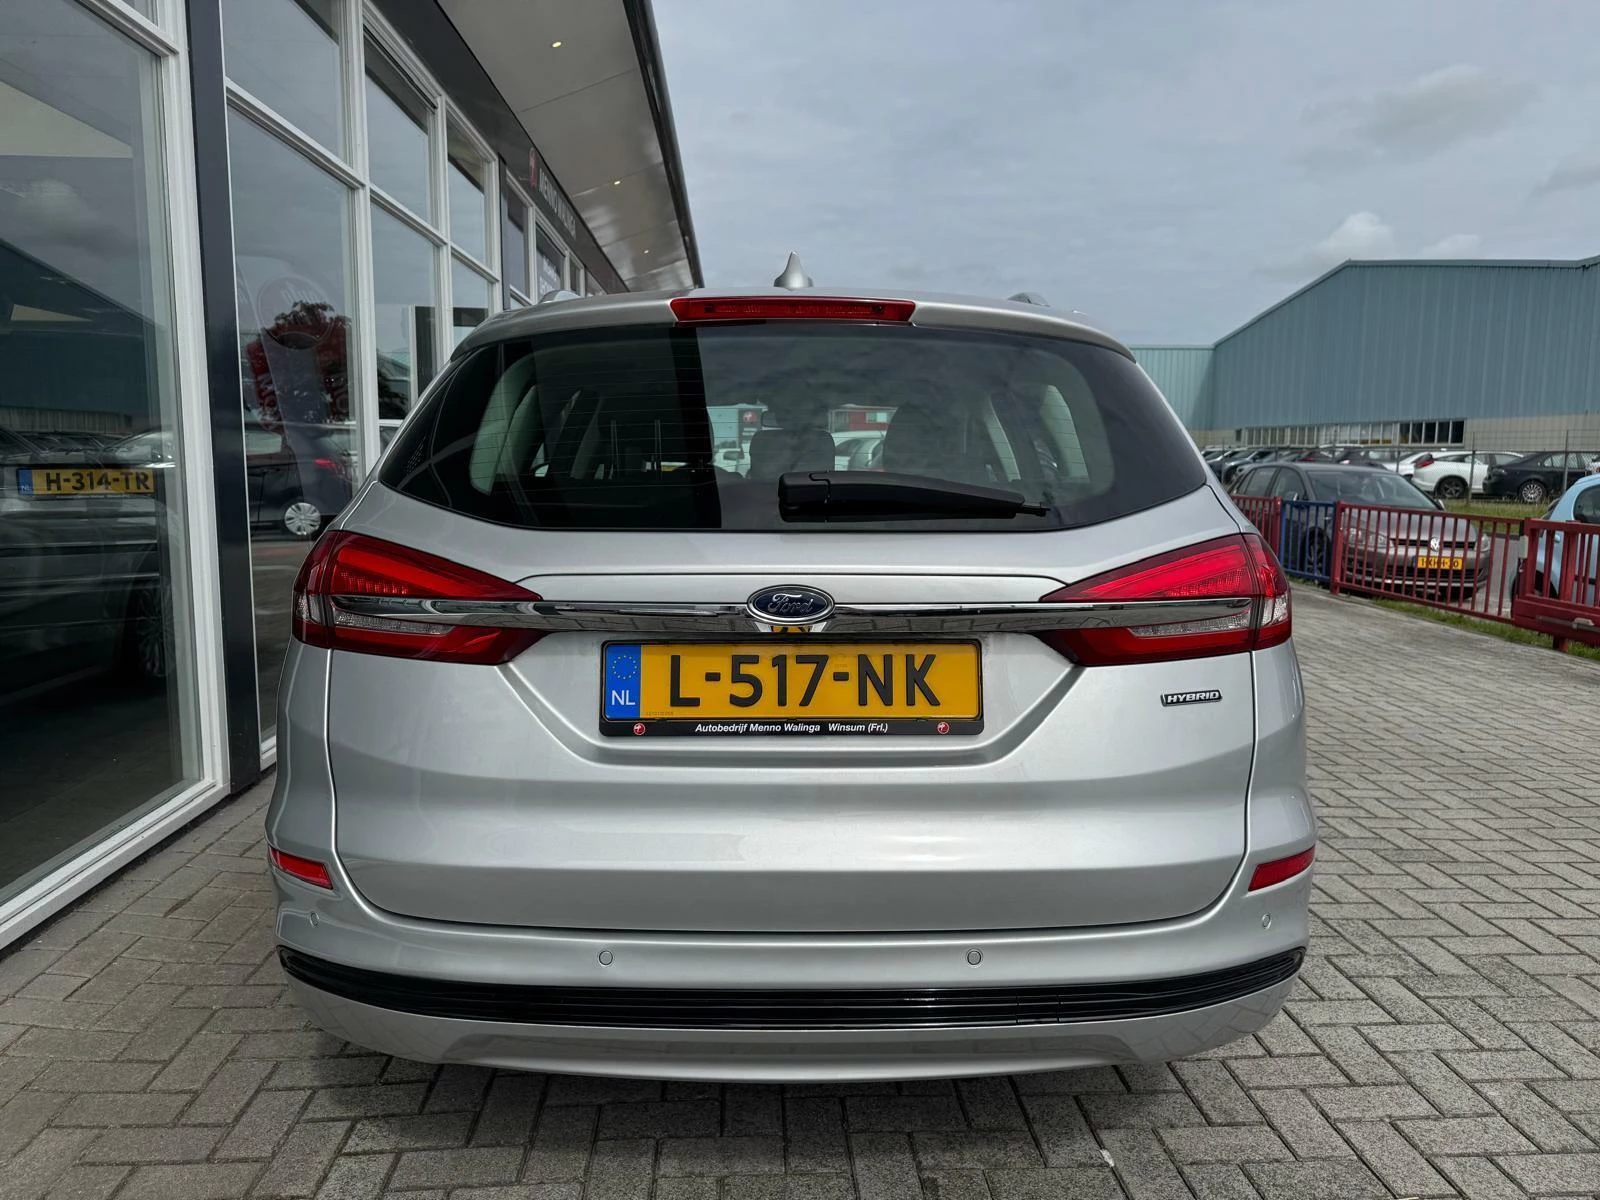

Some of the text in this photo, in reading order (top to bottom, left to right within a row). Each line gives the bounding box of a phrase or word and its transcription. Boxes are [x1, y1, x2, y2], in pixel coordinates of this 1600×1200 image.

[46, 471, 150, 491] H-314-TR
[767, 593, 814, 613] Ford
[670, 654, 941, 708] L-517-NK
[611, 689, 636, 706] NL
[1167, 691, 1220, 703] HYBRID
[695, 723, 889, 734] Autobedrijf Menno Walinga Winsum (Frl.)
